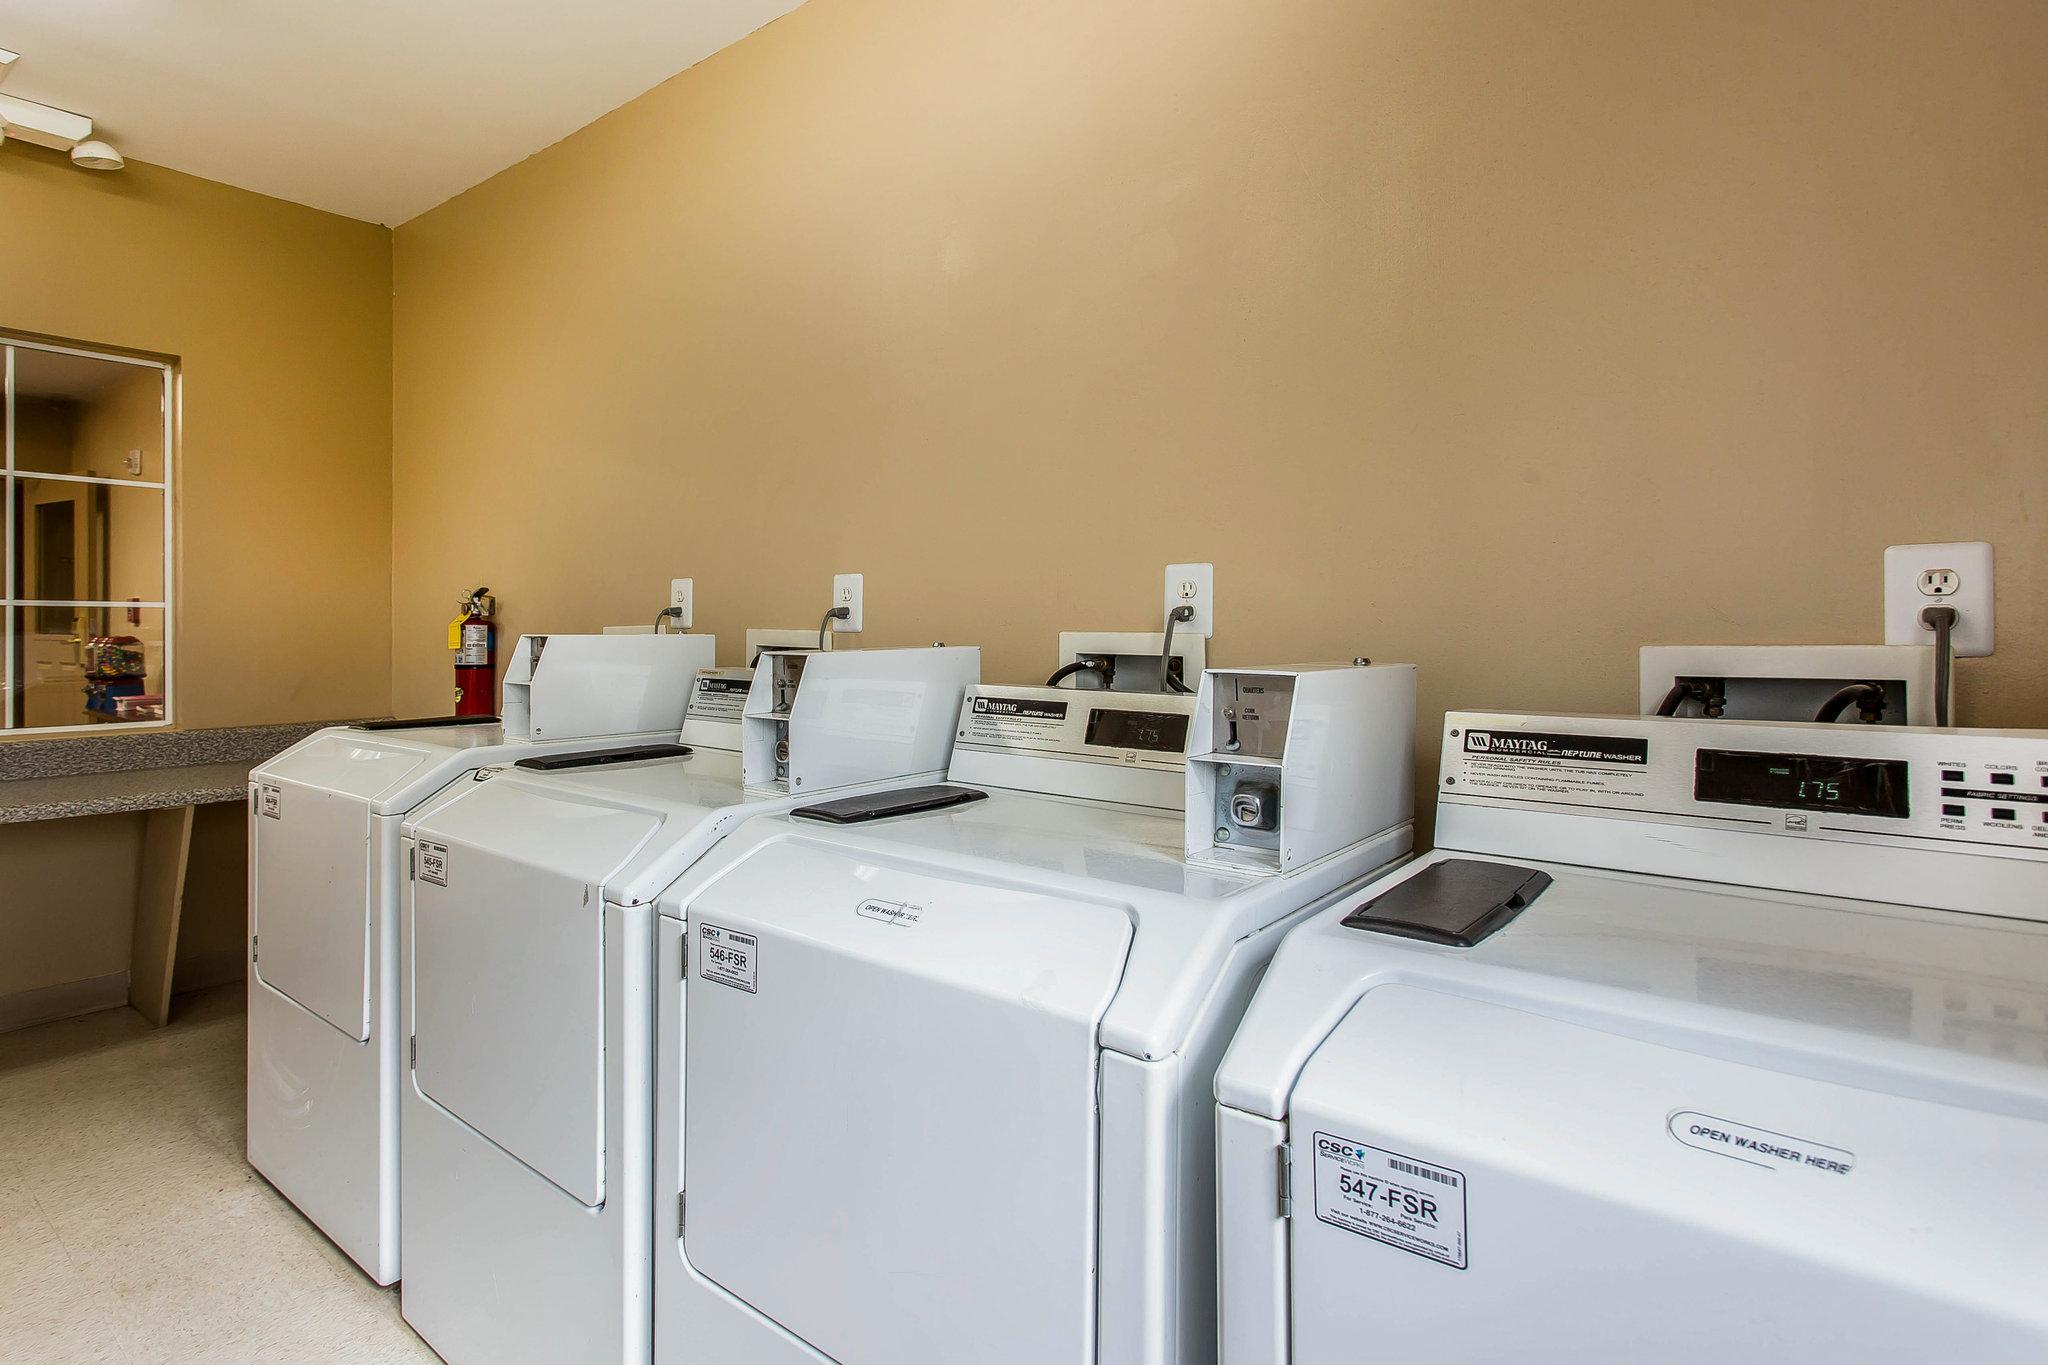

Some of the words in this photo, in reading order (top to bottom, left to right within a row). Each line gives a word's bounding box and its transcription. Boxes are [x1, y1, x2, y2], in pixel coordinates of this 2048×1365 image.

[1242, 686, 1265, 694] QUARTERS
[987, 702, 1018, 712] MAYTAG
[1491, 738, 1548, 752] MAYTAG
[1490, 748, 1547, 756] COMMERCIAL
[1561, 749, 1603, 759] NEPTUNE
[1603, 753, 1642, 762] WASHER
[1966, 791, 1996, 799] FABRIC
[864, 904, 881, 913] OPEN
[702, 927, 716, 936] CSC
[710, 947, 747, 968] 546-FSR
[1318, 1139, 1354, 1157] CSC
[1689, 1124, 1731, 1143] OPEN
[1735, 1136, 1801, 1162] WASHER
[1804, 1154, 1850, 1175] HERE
[1339, 1173, 1440, 1222] 547-FSR
[1359, 1207, 1417, 1232] 1-877-264-6622
